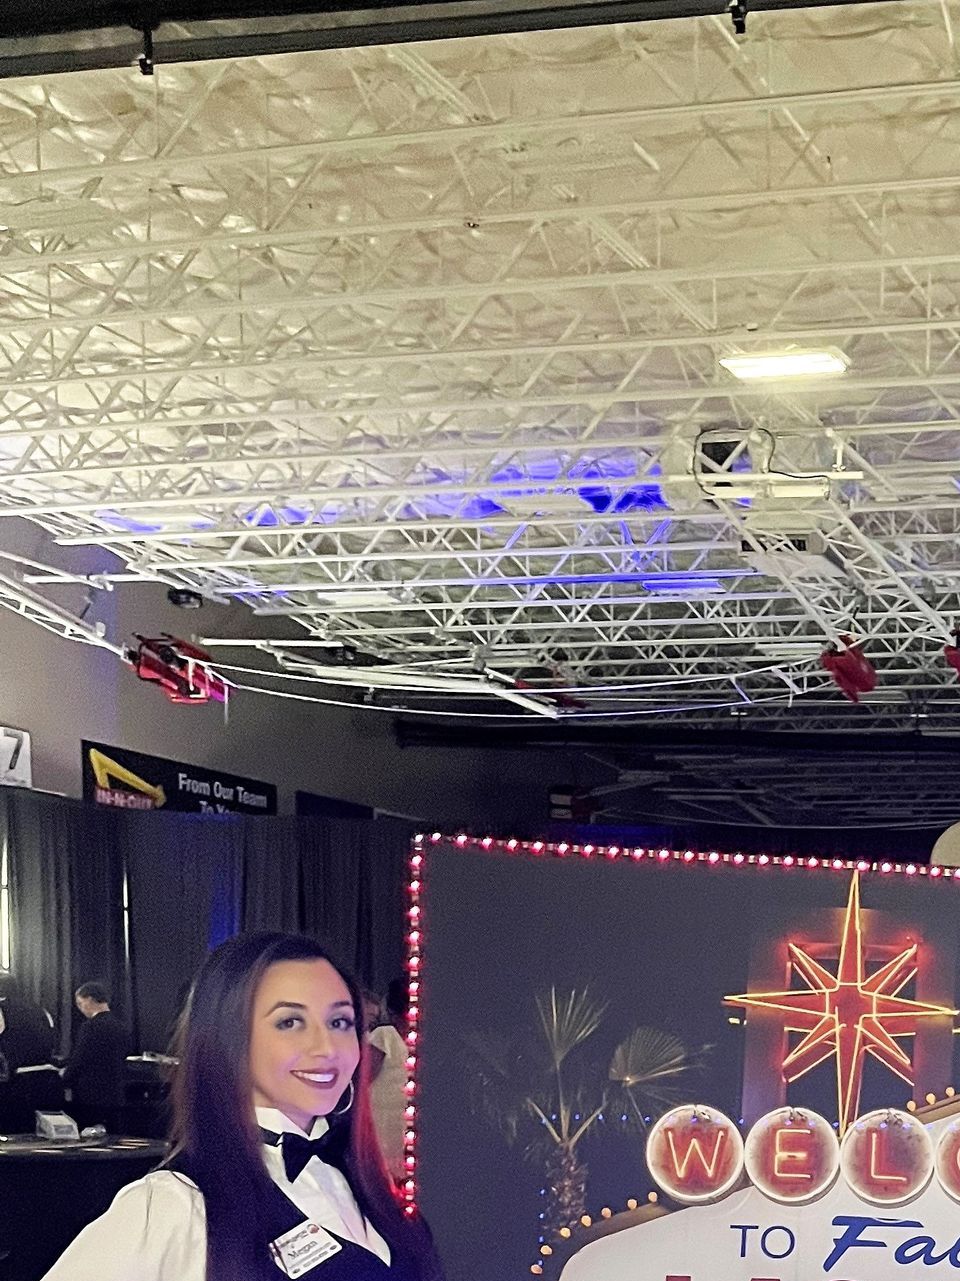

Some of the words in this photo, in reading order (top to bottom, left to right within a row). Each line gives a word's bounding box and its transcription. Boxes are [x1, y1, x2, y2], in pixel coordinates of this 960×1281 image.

[178, 772, 210, 797] From
[213, 781, 234, 801] Our
[236, 786, 267, 808] Team
[730, 1224, 796, 1259] TO
